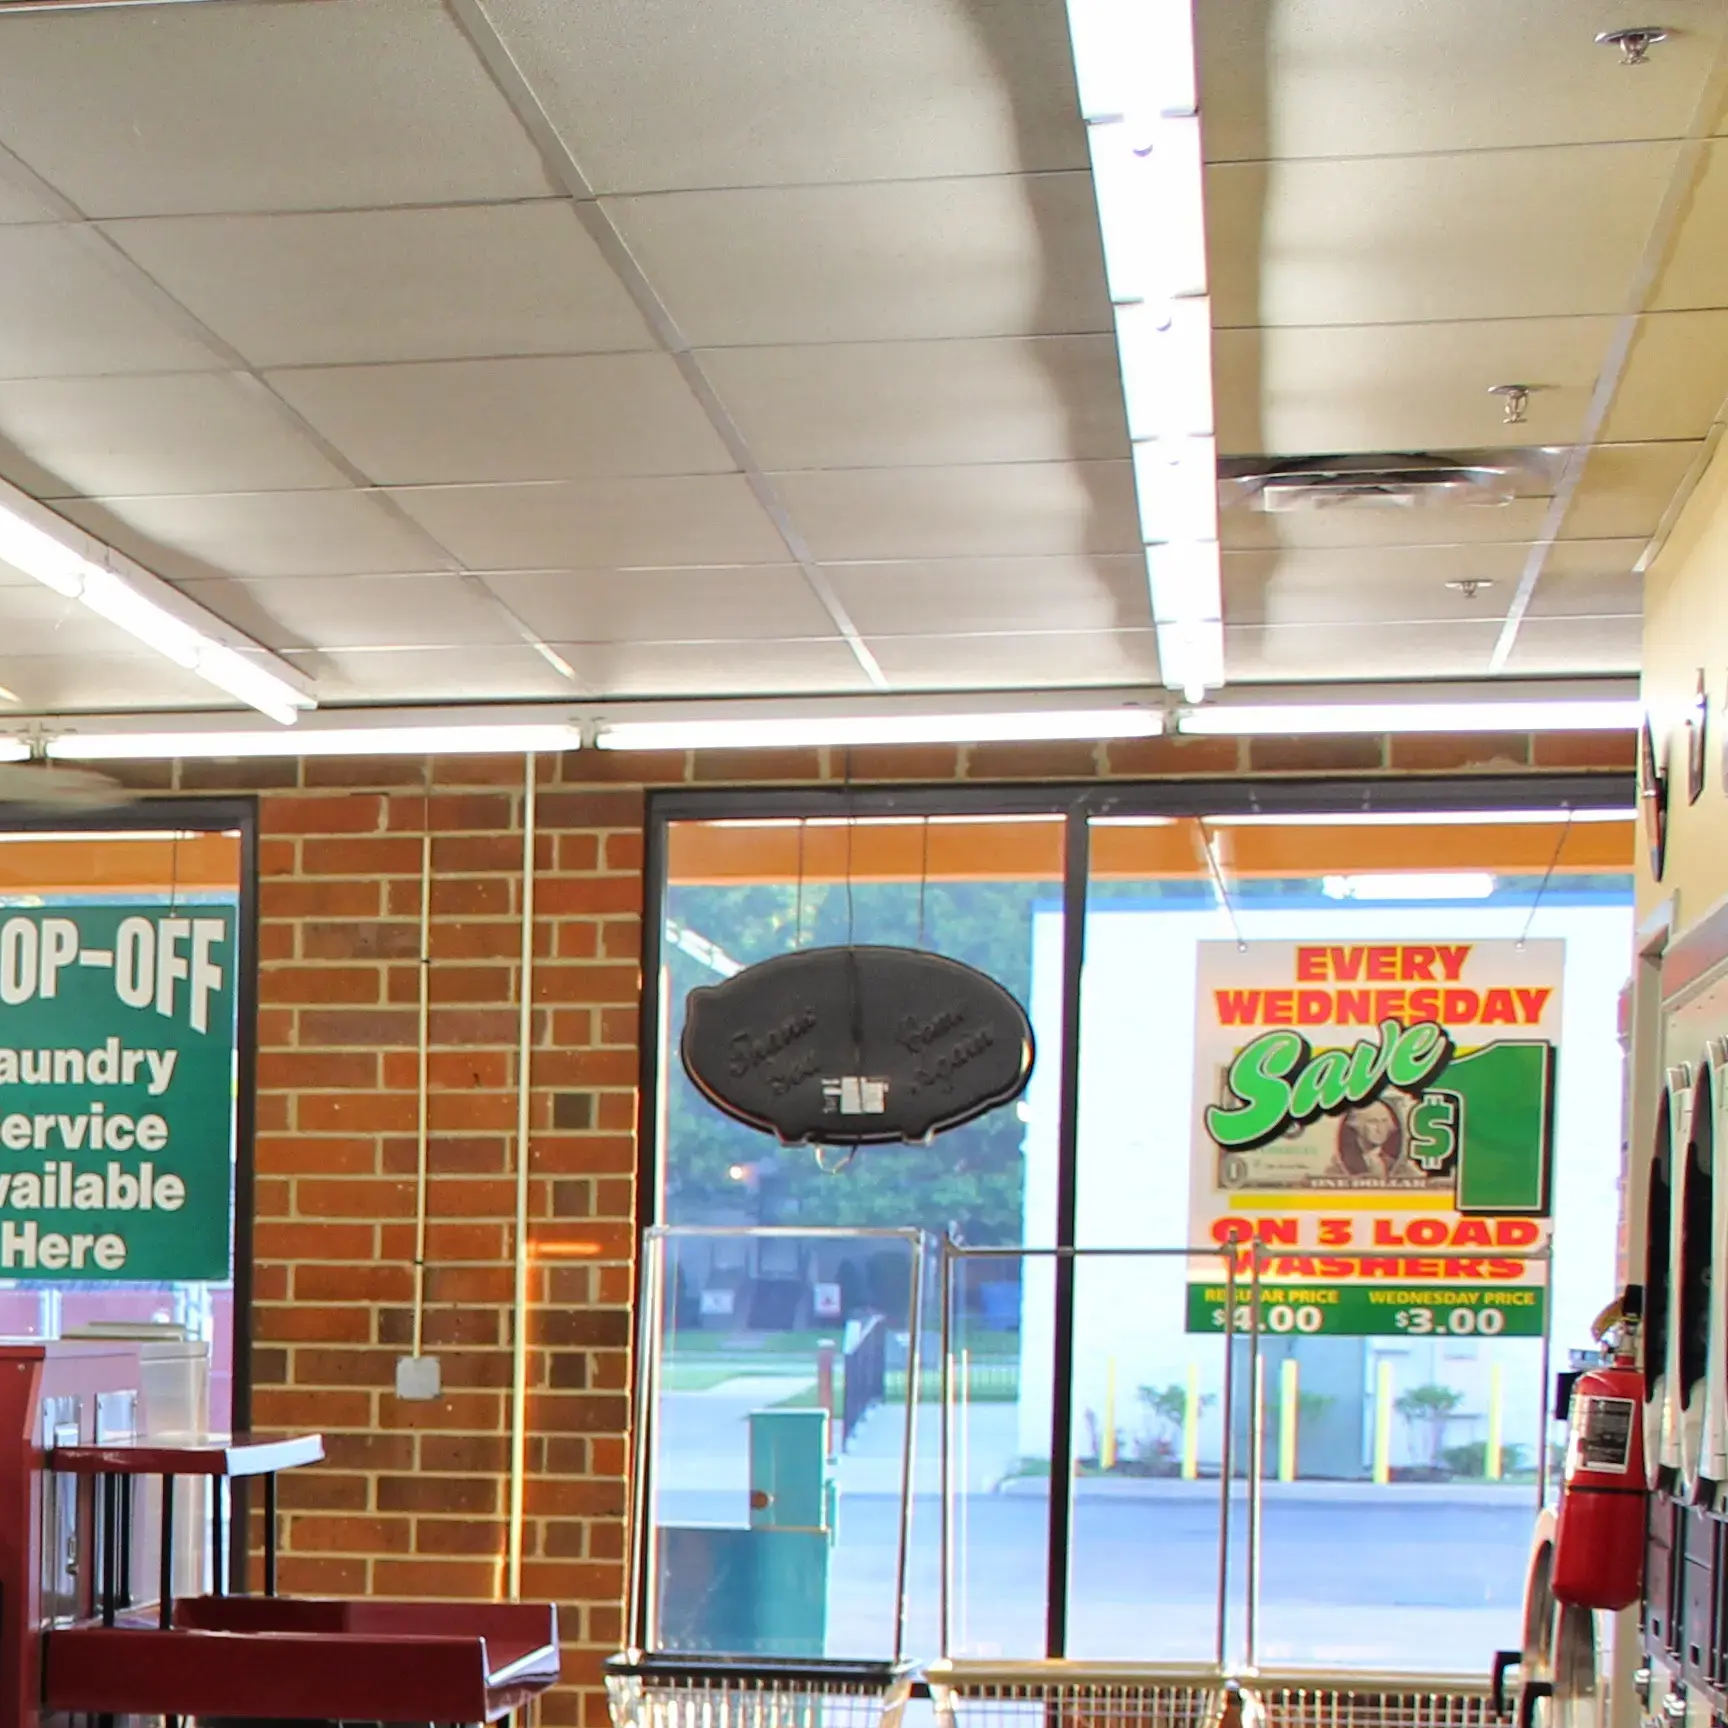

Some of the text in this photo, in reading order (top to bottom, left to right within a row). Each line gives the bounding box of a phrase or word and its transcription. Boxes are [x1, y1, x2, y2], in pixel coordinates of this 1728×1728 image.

[1296, 945, 1474, 982] EVERY
[1213, 986, 1555, 1027] WEDNESDAY
[1204, 1016, 1450, 1148] Save
[0, 1220, 128, 1270] Here
[1210, 1217, 1540, 1248] ON 3 LOAD
[1224, 1250, 1527, 1280] WASHERS
[1287, 1289, 1340, 1304] PRICE
[1368, 1290, 1536, 1306] WEDNESDAY PRICE
[1394, 1307, 1505, 1335] $3.00
